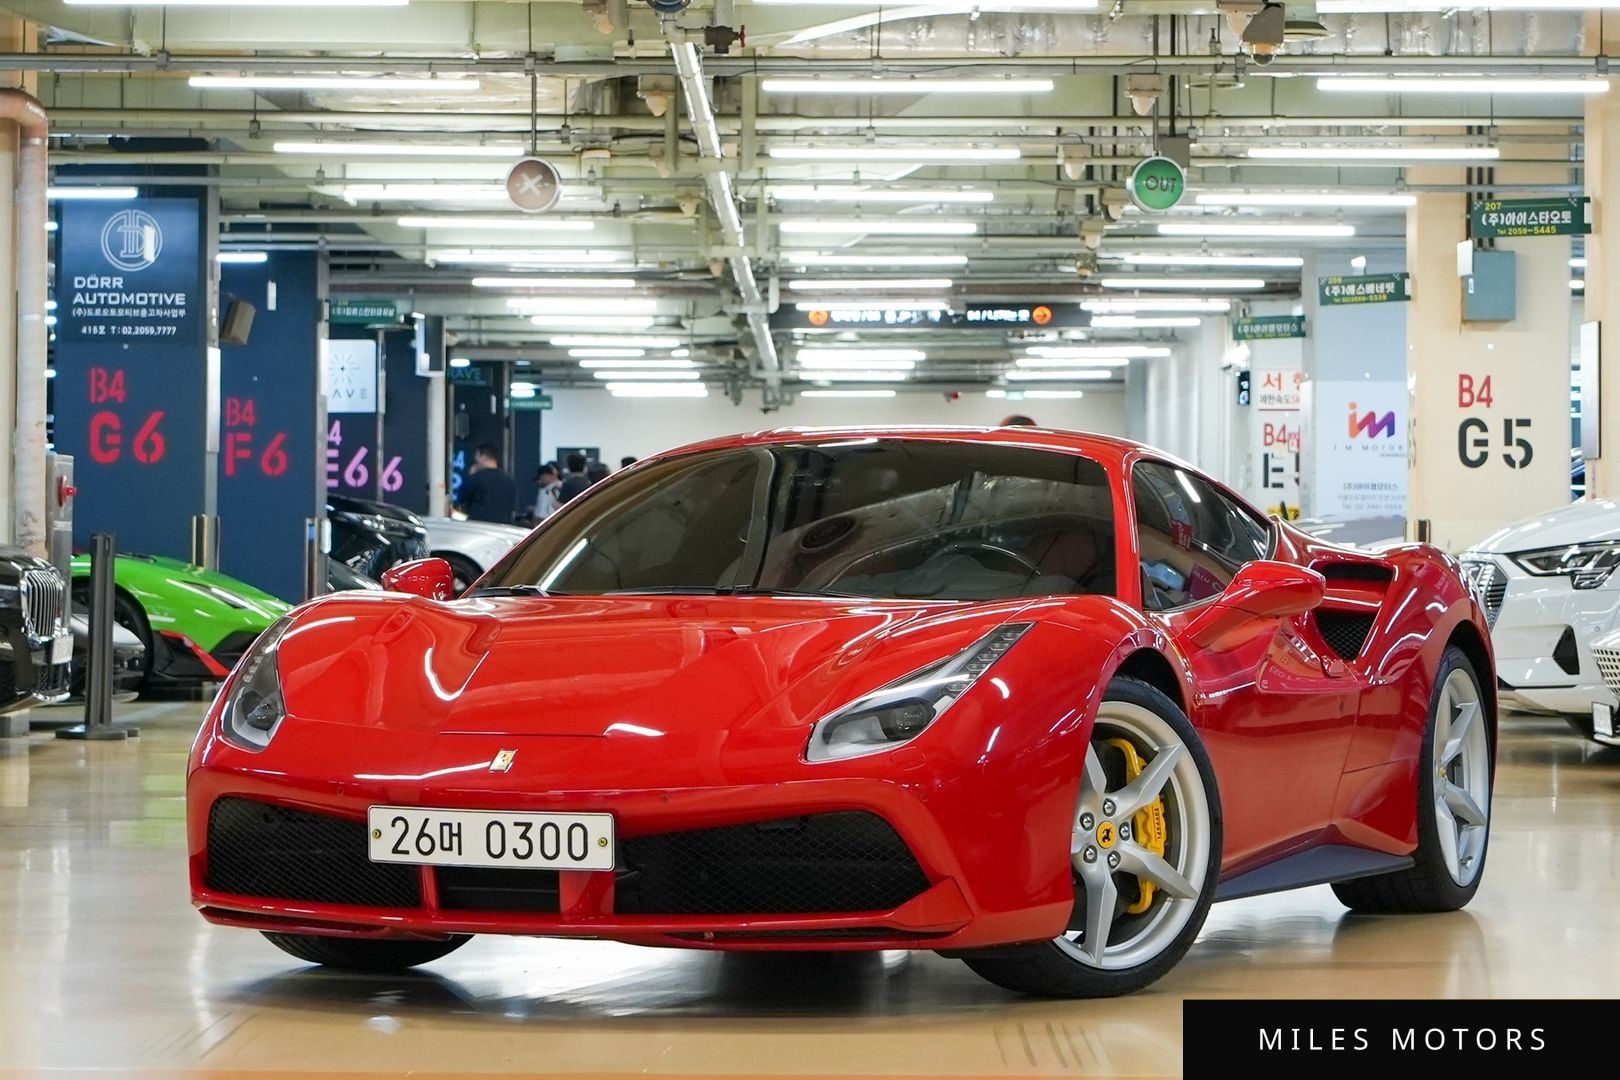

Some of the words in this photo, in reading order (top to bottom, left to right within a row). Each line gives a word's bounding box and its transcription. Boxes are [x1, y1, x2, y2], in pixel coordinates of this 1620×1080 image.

[1145, 175, 1177, 192] OUT
[1485, 202, 1502, 211] 207
[1481, 210, 1572, 226] (주)아이스타오토
[1508, 226, 1557, 235] 2059-5445
[73, 274, 124, 289] DÖRR
[72, 293, 187, 306] AUTOMOTIVE
[89, 368, 127, 403] B4
[1458, 374, 1493, 408] B4
[226, 397, 256, 426] B4
[391, 815, 463, 857] 26머
[485, 820, 589, 862] 0300
